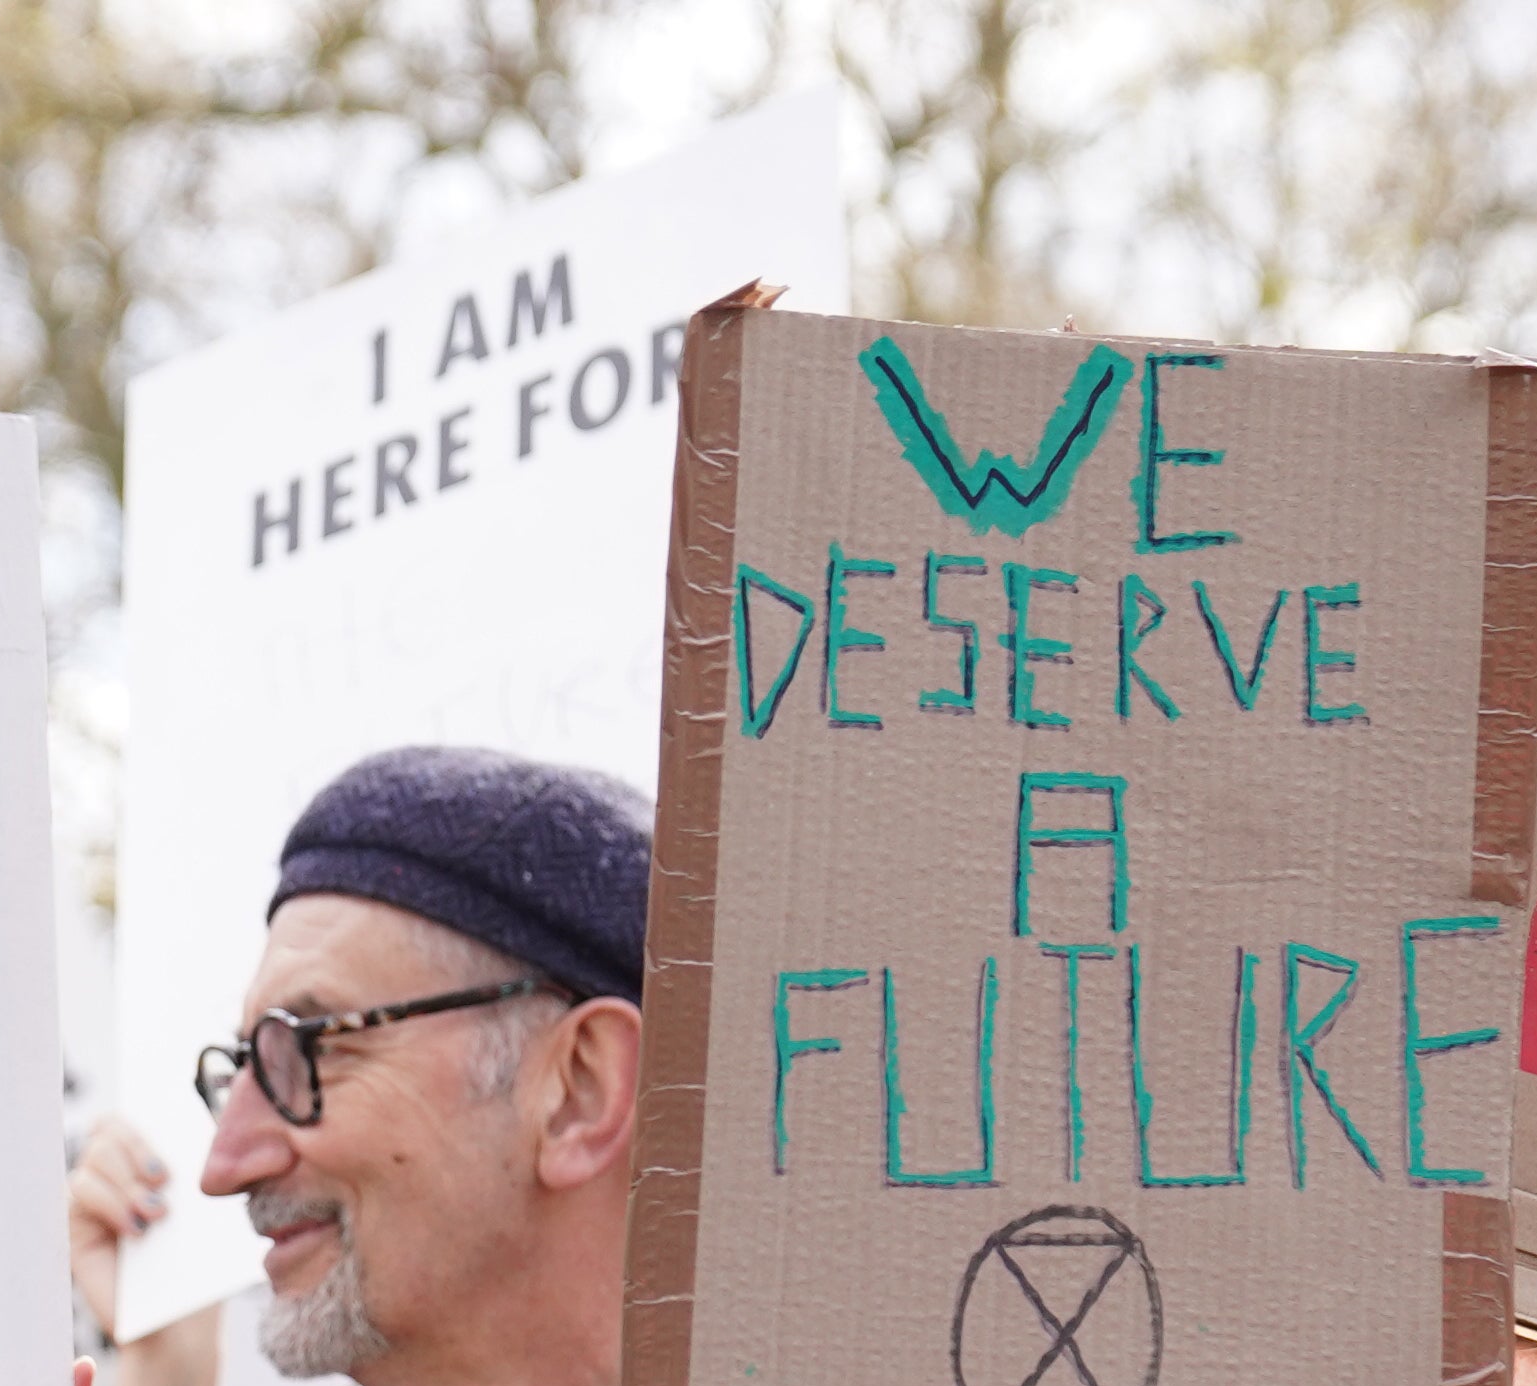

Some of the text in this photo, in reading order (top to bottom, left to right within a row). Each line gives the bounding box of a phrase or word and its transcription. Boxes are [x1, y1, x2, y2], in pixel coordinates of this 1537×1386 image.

[369, 252, 576, 407] I AM
[248, 405, 473, 570] HERE
[858, 336, 1244, 554] WE
[733, 540, 1369, 738] DESERVE
[1015, 770, 1128, 938] A
[774, 912, 1502, 1190] FUTURE
